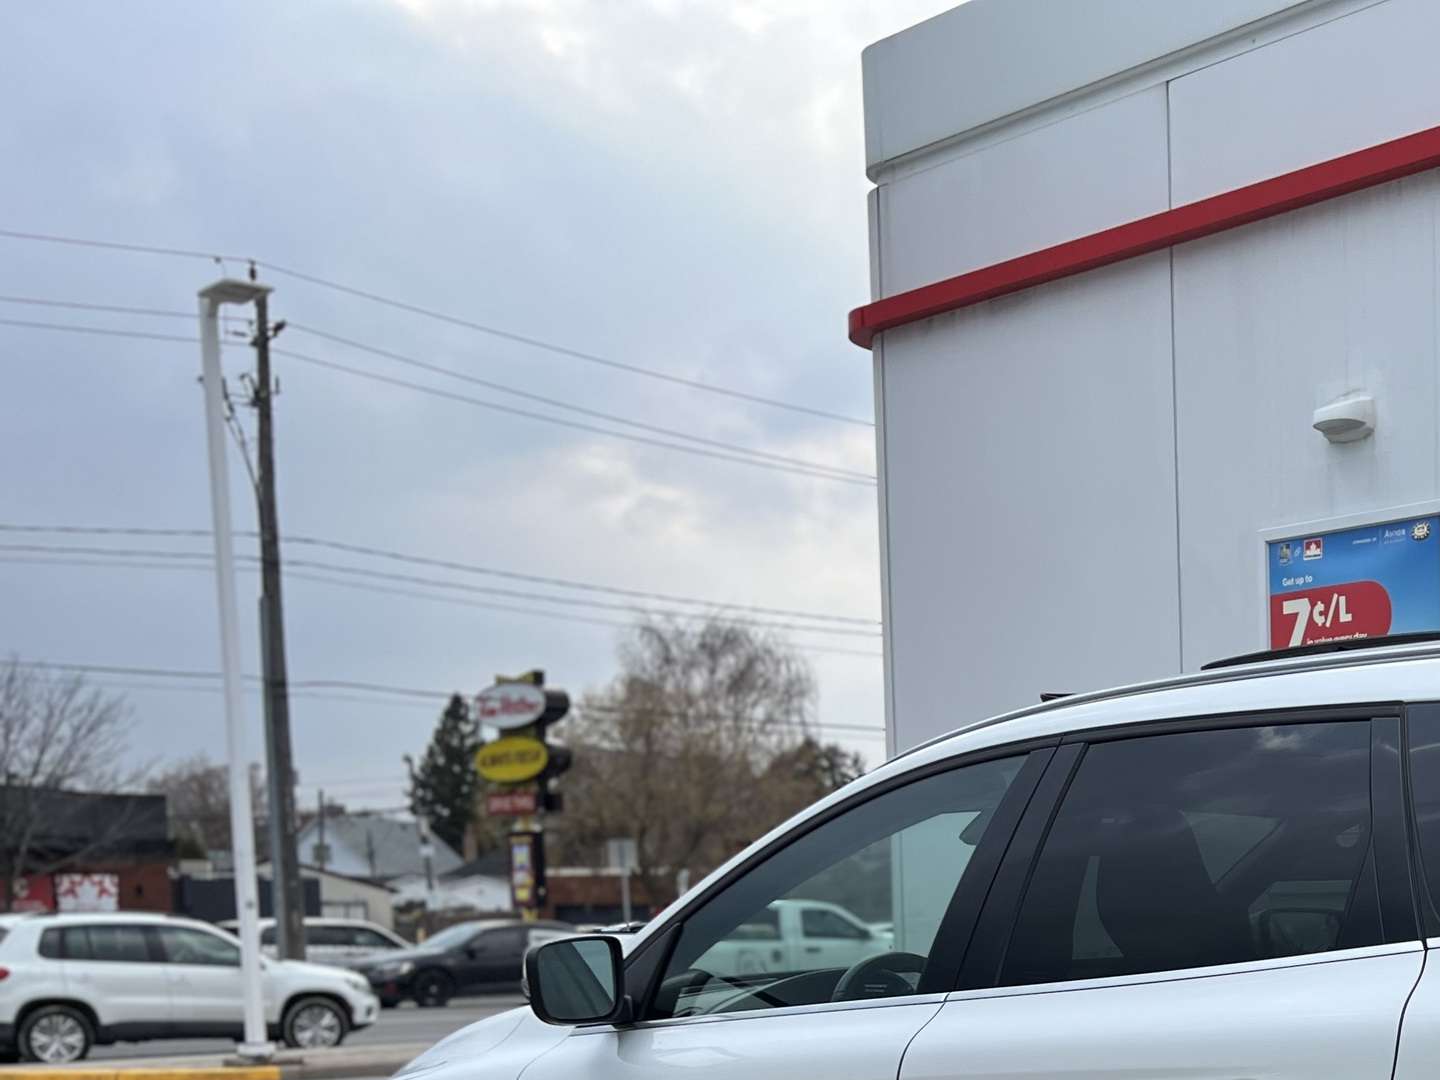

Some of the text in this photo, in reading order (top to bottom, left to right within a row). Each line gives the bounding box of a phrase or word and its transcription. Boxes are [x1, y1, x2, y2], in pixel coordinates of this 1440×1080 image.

[1282, 575, 1313, 586] Get up to
